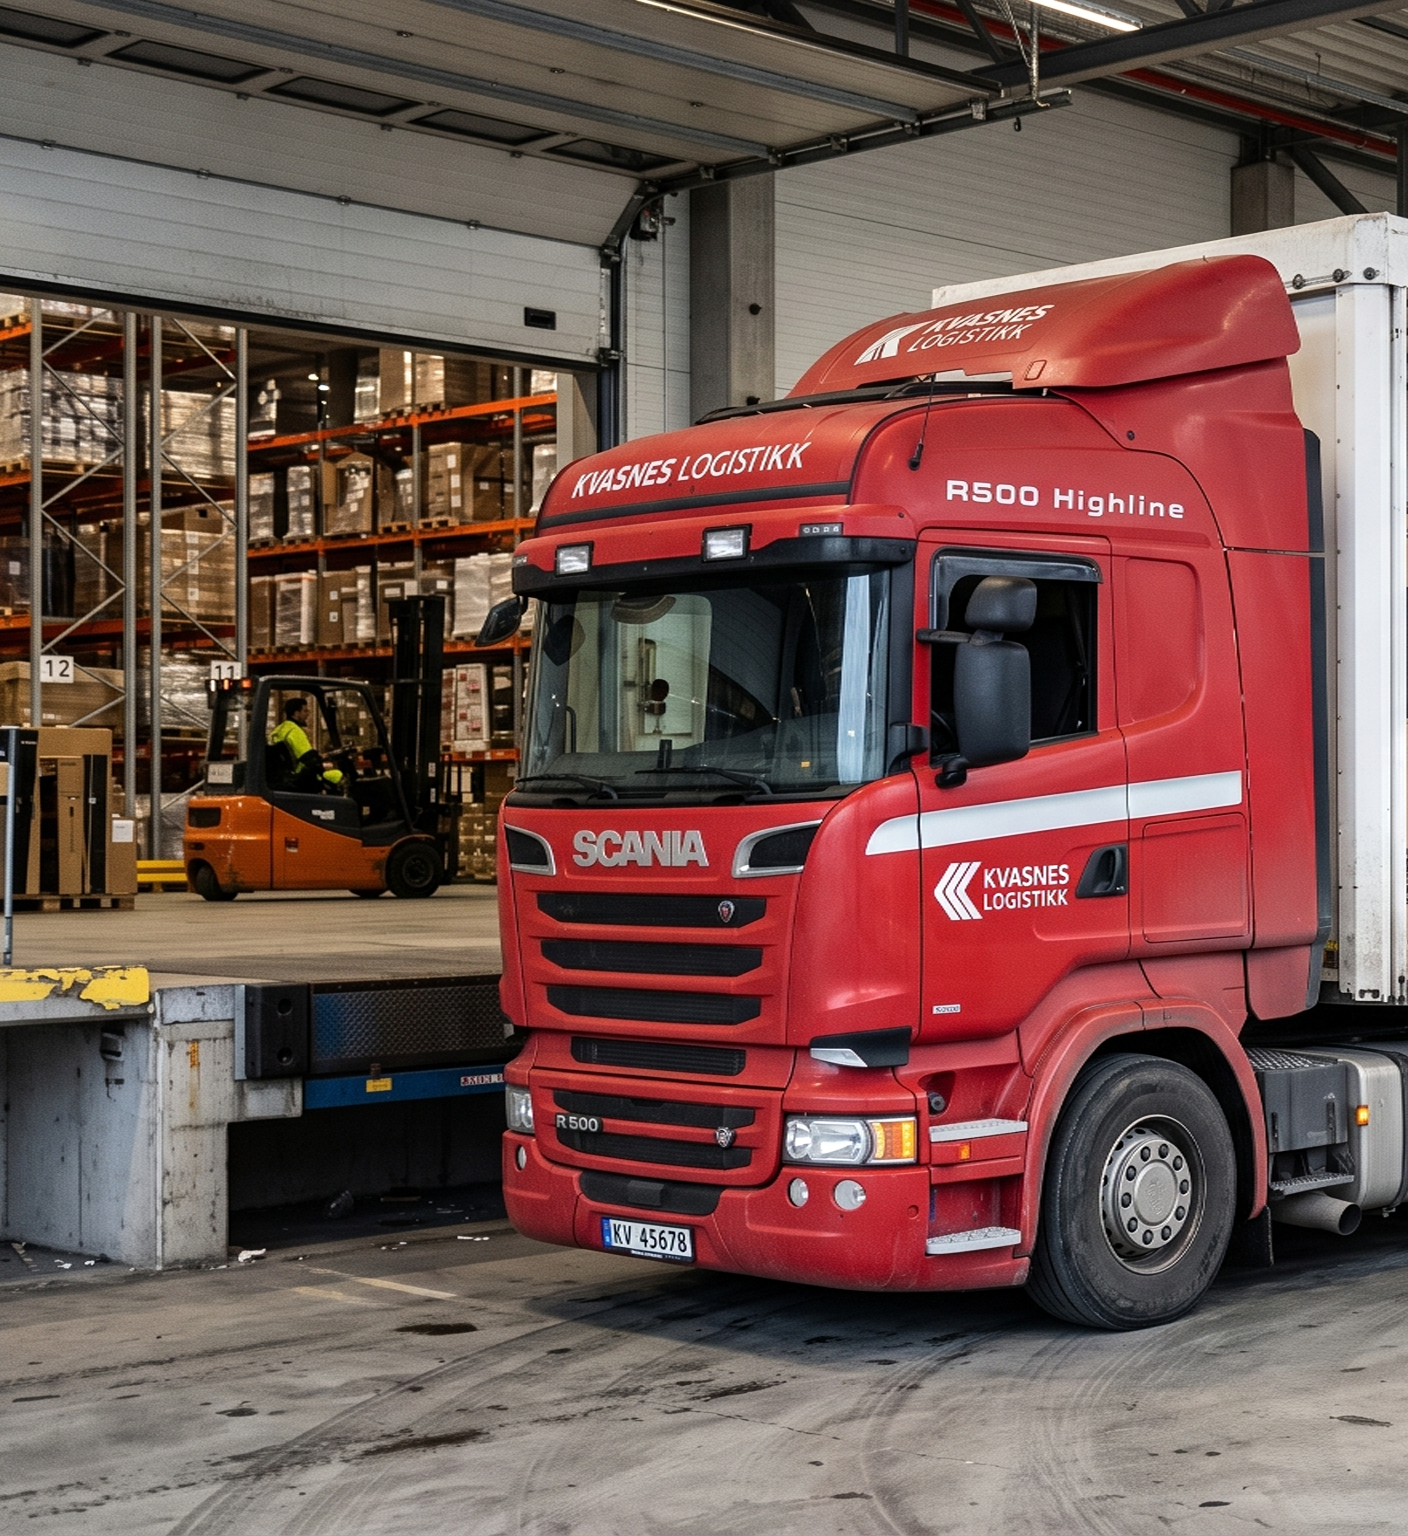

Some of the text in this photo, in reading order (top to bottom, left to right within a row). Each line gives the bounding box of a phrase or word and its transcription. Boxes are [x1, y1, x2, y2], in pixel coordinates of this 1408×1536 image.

[922, 304, 1055, 335] KVASNES
[906, 323, 1033, 353] LOGISTIKK
[571, 442, 812, 499] KVASNES LOGISTIKK
[946, 479, 1185, 519] R500 Highline
[44, 659, 70, 678] 12
[215, 665, 235, 680] 11
[572, 830, 709, 867] SCANIA
[983, 864, 1070, 888] KVASNES
[983, 888, 1068, 911] LOGISTIKK
[613, 1223, 687, 1253] KV 45678
